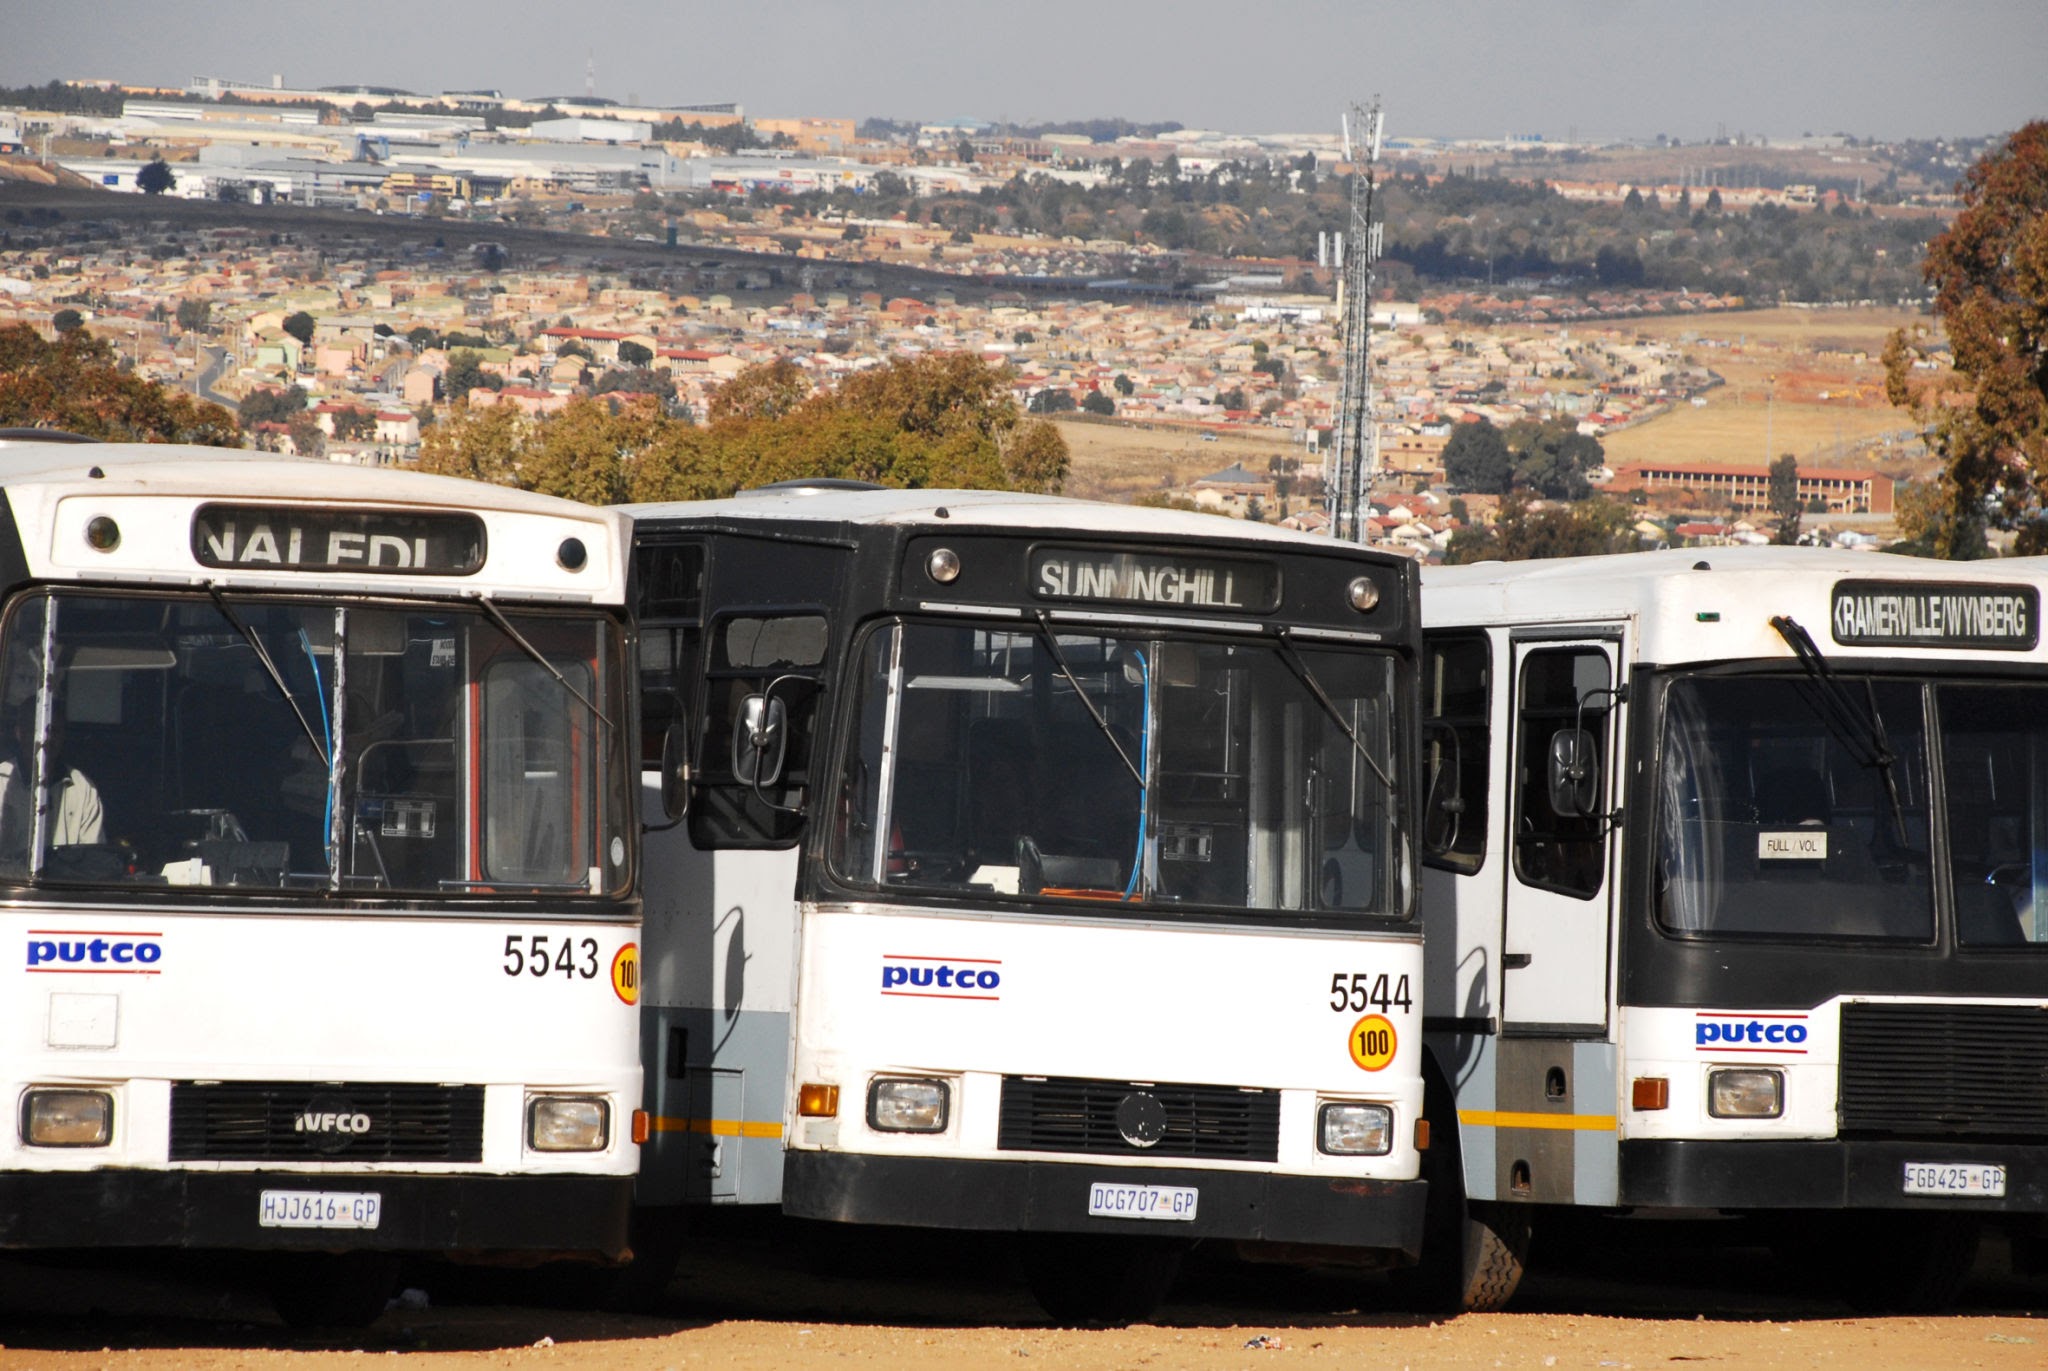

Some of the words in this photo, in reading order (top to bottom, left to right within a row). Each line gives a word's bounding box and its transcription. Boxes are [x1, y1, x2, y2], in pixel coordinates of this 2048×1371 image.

[1767, 839, 1789, 852] FULL
[1799, 839, 1817, 852] VOL
[27, 938, 162, 965] putco
[503, 935, 599, 979] 5543
[882, 965, 1001, 989] putco
[1330, 973, 1413, 1014] 5544
[1358, 1029, 1389, 1056] 100
[1695, 1020, 1808, 1045] putco
[1906, 1168, 1967, 1189] FGB425
[1982, 1169, 2001, 1189] GP
[264, 1197, 336, 1220] HJJ616
[353, 1199, 376, 1222] GP
[1093, 1189, 1159, 1212] DCG707
[1173, 1192, 1194, 1213] GP
